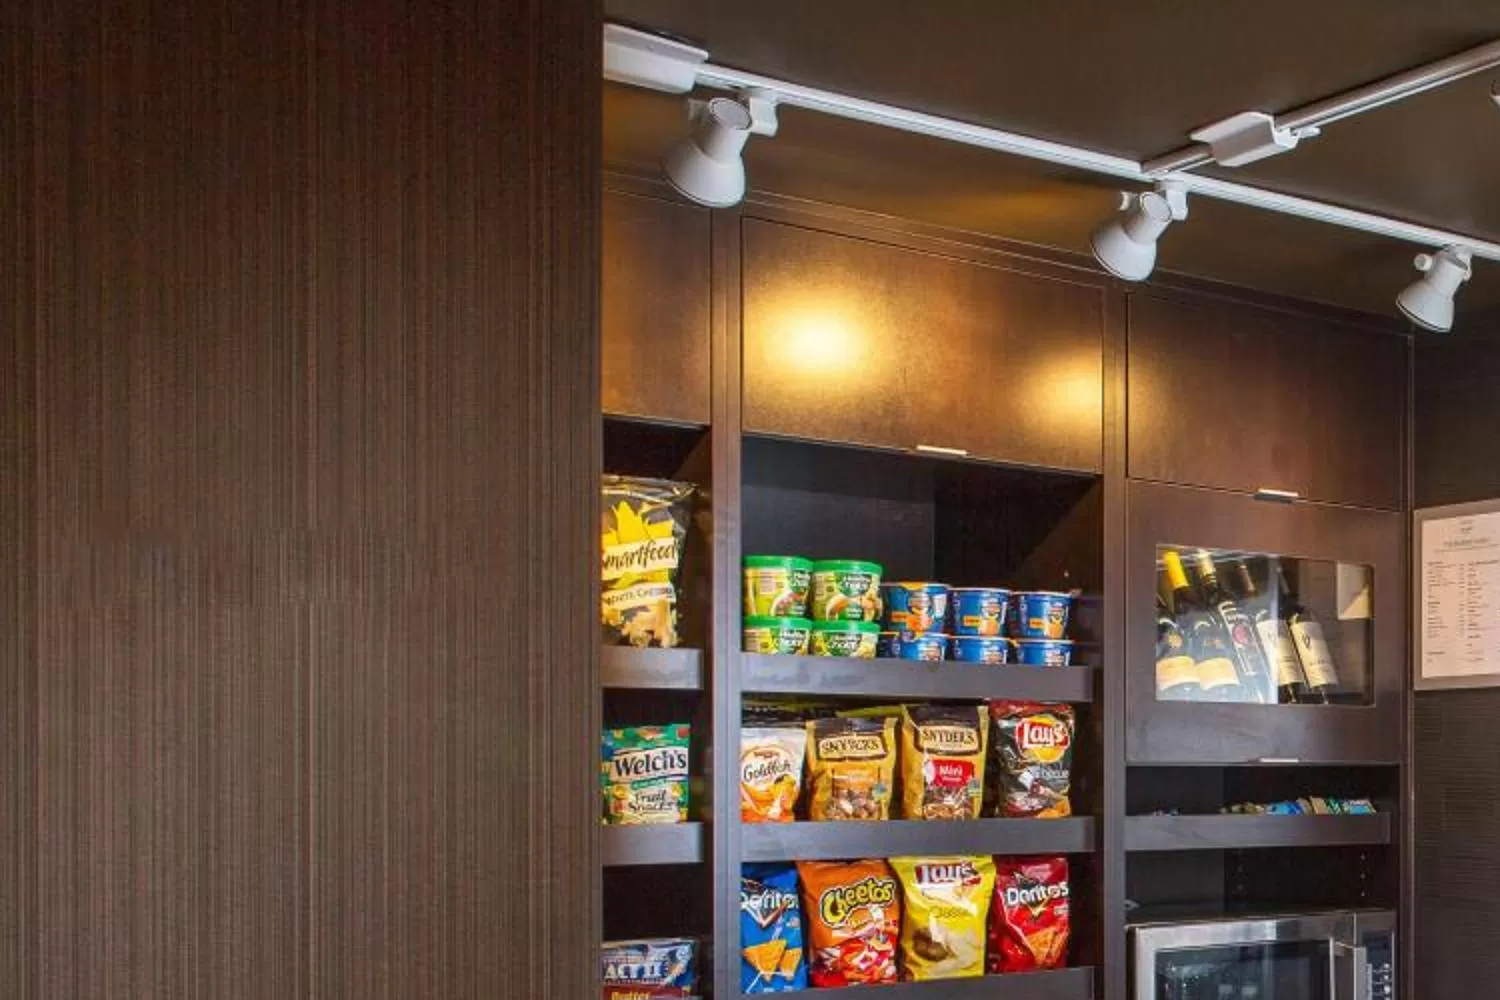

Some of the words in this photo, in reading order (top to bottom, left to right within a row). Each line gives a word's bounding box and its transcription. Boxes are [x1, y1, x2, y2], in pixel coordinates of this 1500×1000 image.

[604, 541, 676, 571] martfood
[615, 749, 687, 777] Welch's
[822, 878, 894, 925] Cheetos
[1006, 881, 1069, 905] Doritos
